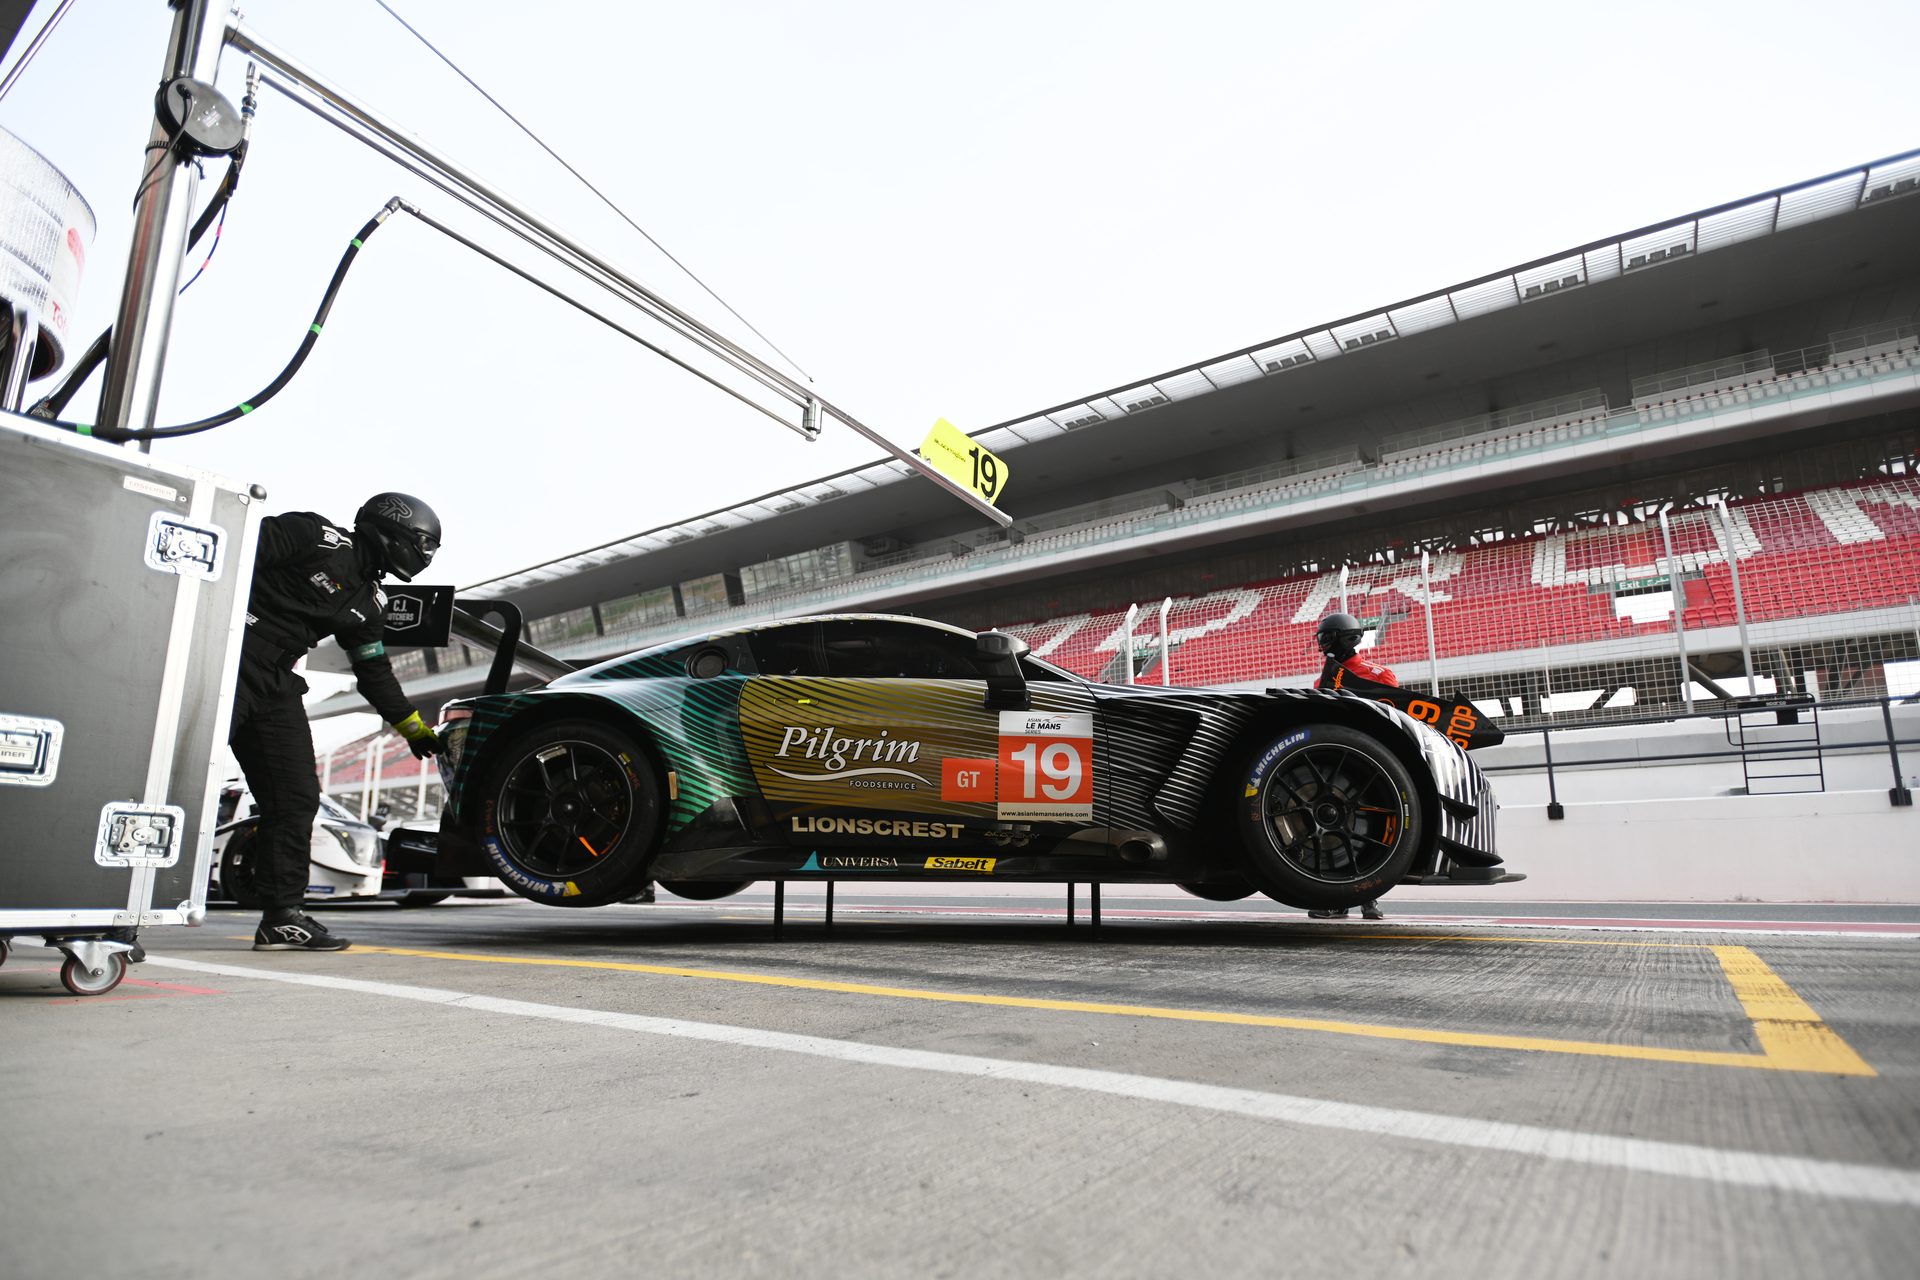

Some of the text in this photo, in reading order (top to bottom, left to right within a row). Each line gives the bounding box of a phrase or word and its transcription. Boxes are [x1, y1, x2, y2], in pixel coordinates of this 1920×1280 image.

[968, 446, 998, 499] 19
[1619, 580, 1641, 590] Exit
[1025, 722, 1062, 730] LE MANS
[1446, 705, 1478, 750] STOP
[774, 726, 921, 771] Pilgrim
[1255, 732, 1305, 776] MICHELIN
[956, 770, 981, 788] GT
[1011, 742, 1083, 801] 19
[849, 780, 917, 791] FOODSERVICE
[1000, 810, 1089, 818] www.asianlemansseries.com
[791, 816, 965, 839] LIONSCREST
[487, 842, 550, 893] MICHELIN
[822, 856, 899, 868] UNIVERSA
[932, 857, 989, 870] Sabelt
